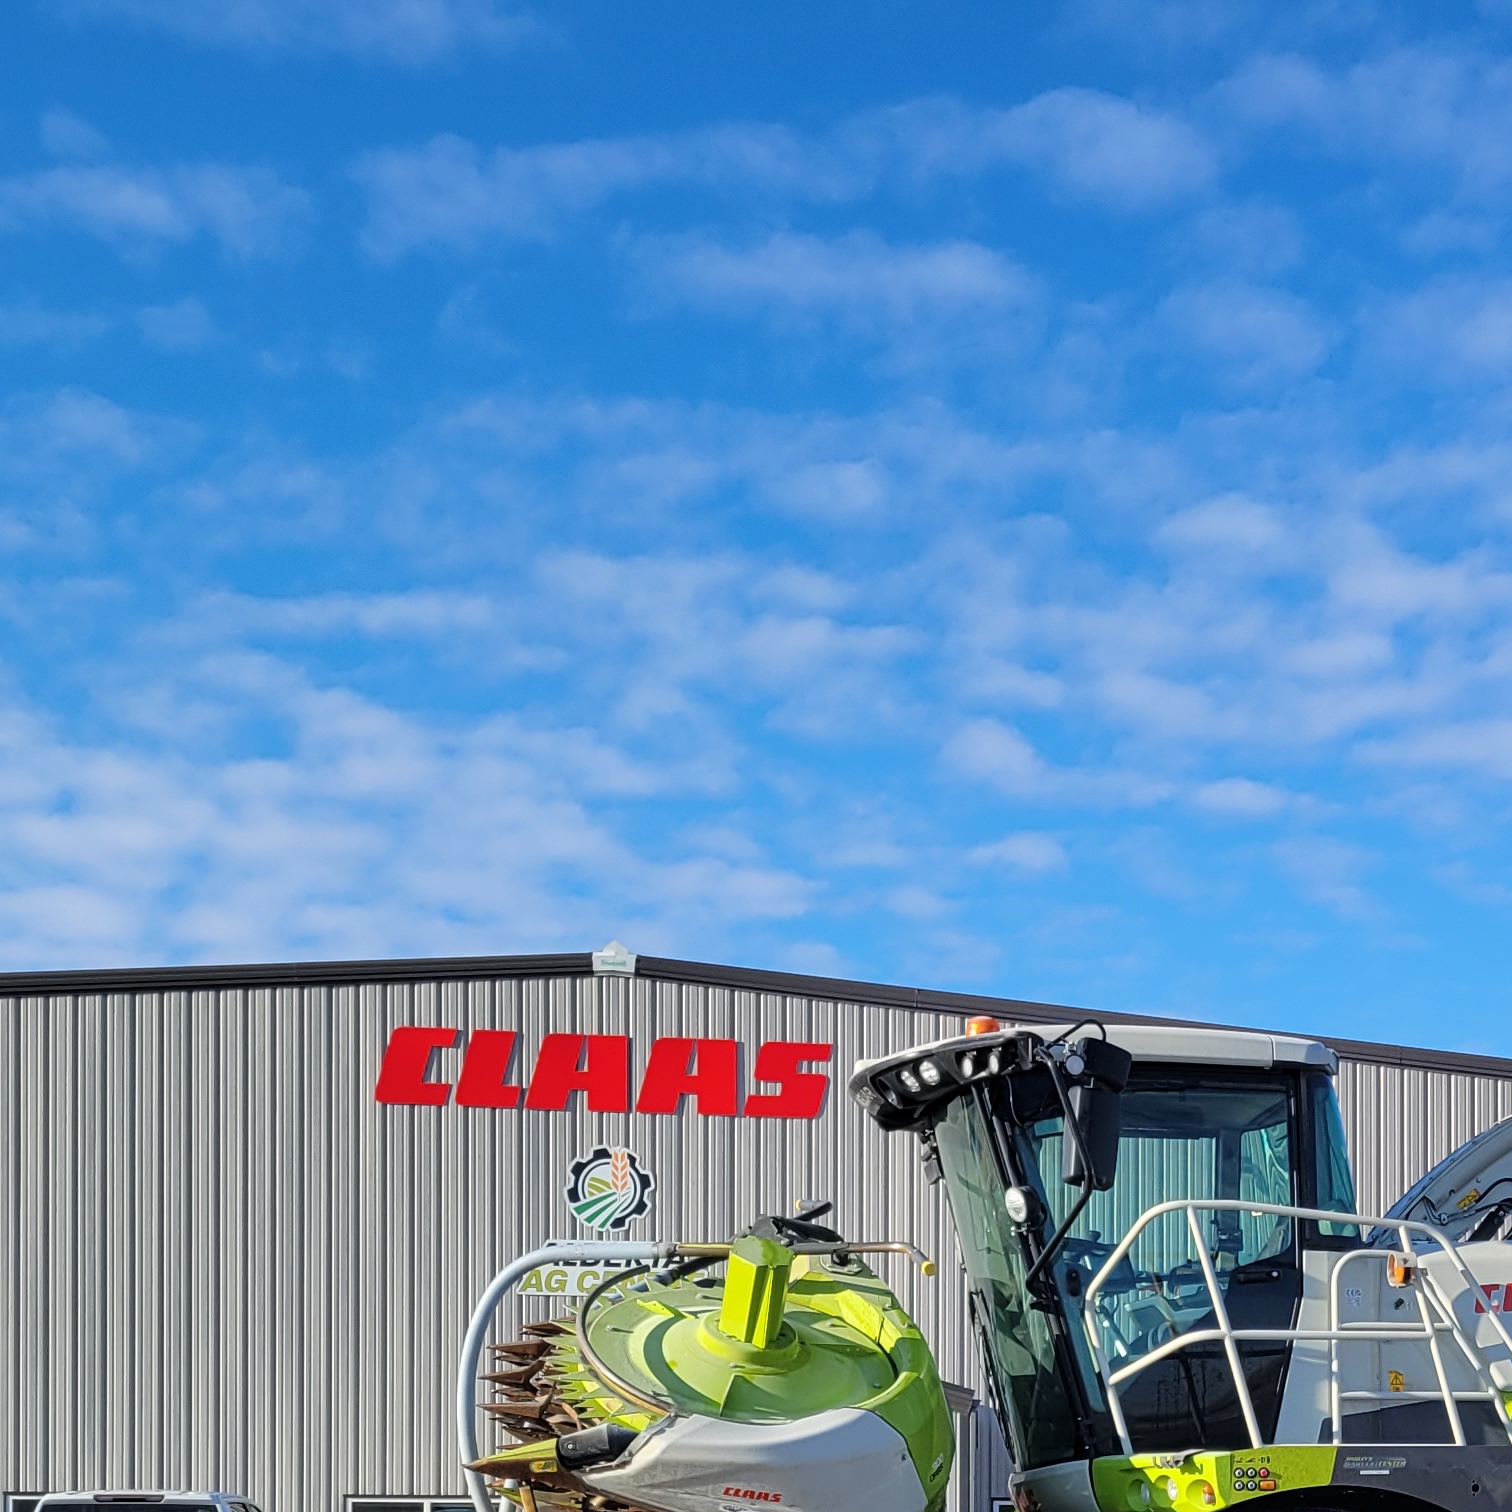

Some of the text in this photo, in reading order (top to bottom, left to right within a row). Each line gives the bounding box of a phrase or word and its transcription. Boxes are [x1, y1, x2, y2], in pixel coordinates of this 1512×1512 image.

[375, 1026, 833, 1119] CLAAS
[519, 1270, 567, 1292] AG
[722, 1486, 783, 1503] CLAAS
